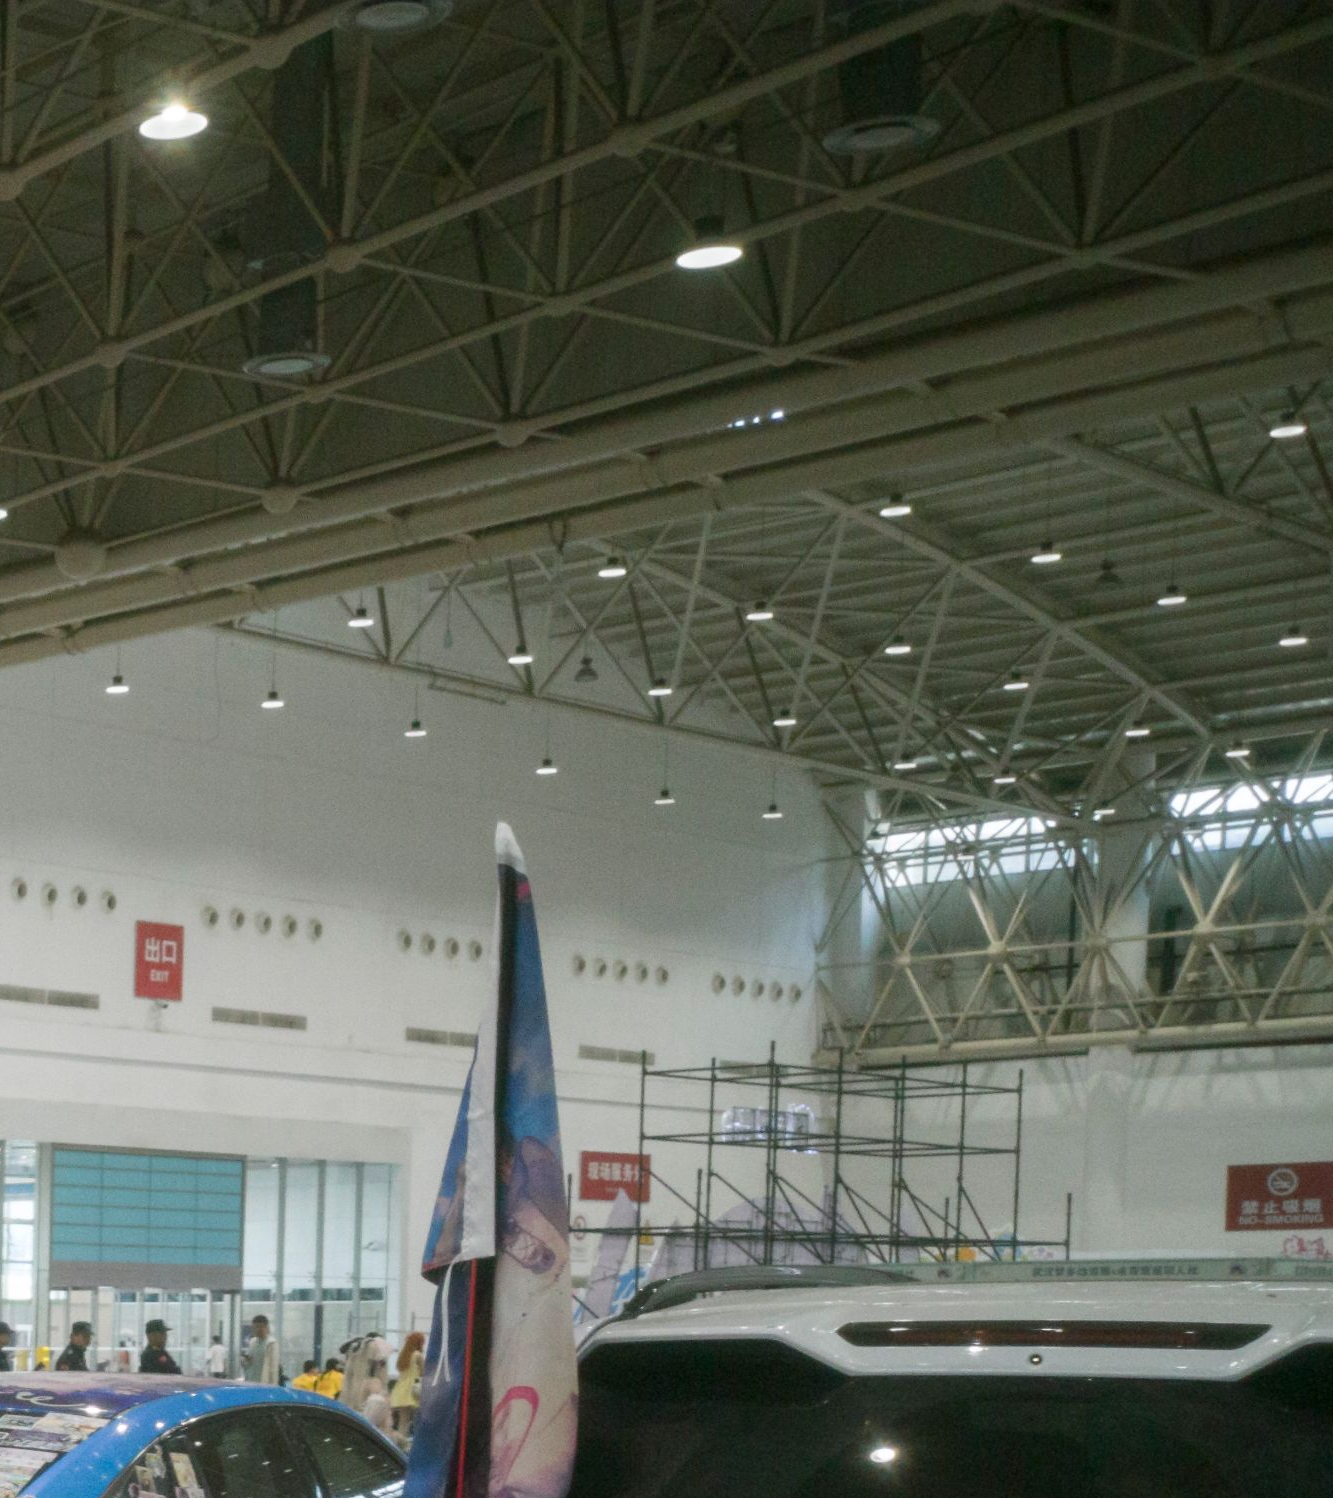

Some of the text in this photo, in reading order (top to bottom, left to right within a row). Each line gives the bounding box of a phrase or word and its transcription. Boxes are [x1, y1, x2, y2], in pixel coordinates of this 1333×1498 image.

[144, 937, 177, 963] 出口
[149, 970, 169, 983] EXIT
[1241, 1200, 1322, 1215] 禁止吸烟
